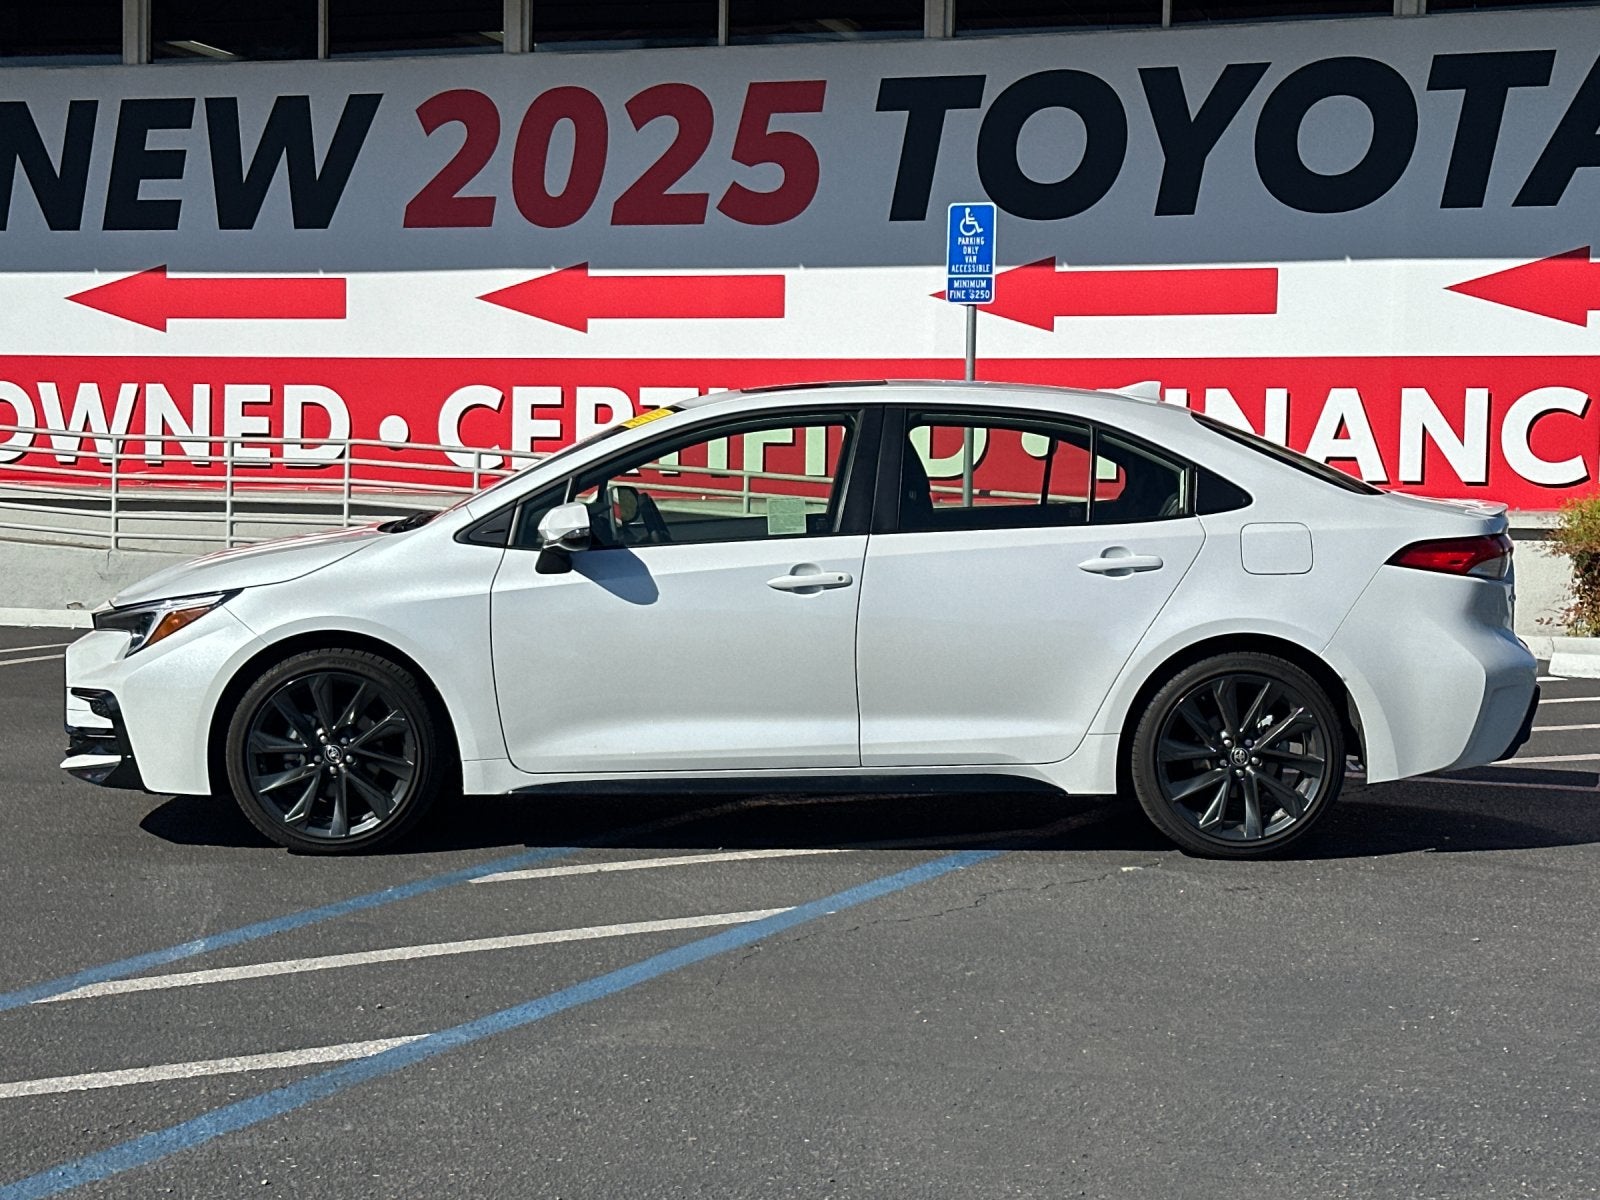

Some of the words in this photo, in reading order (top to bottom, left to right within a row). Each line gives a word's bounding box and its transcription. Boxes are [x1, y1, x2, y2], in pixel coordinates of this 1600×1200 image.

[0, 93, 383, 231] NEW
[404, 81, 824, 227] 2025
[957, 237, 985, 245] PARKING
[963, 246, 979, 254] ONLY
[965, 255, 977, 264] VAN
[951, 264, 991, 273] ACCESSIBLE
[953, 279, 987, 289] MINIMUM
[949, 290, 966, 299] FINE
[969, 289, 990, 300] $250
